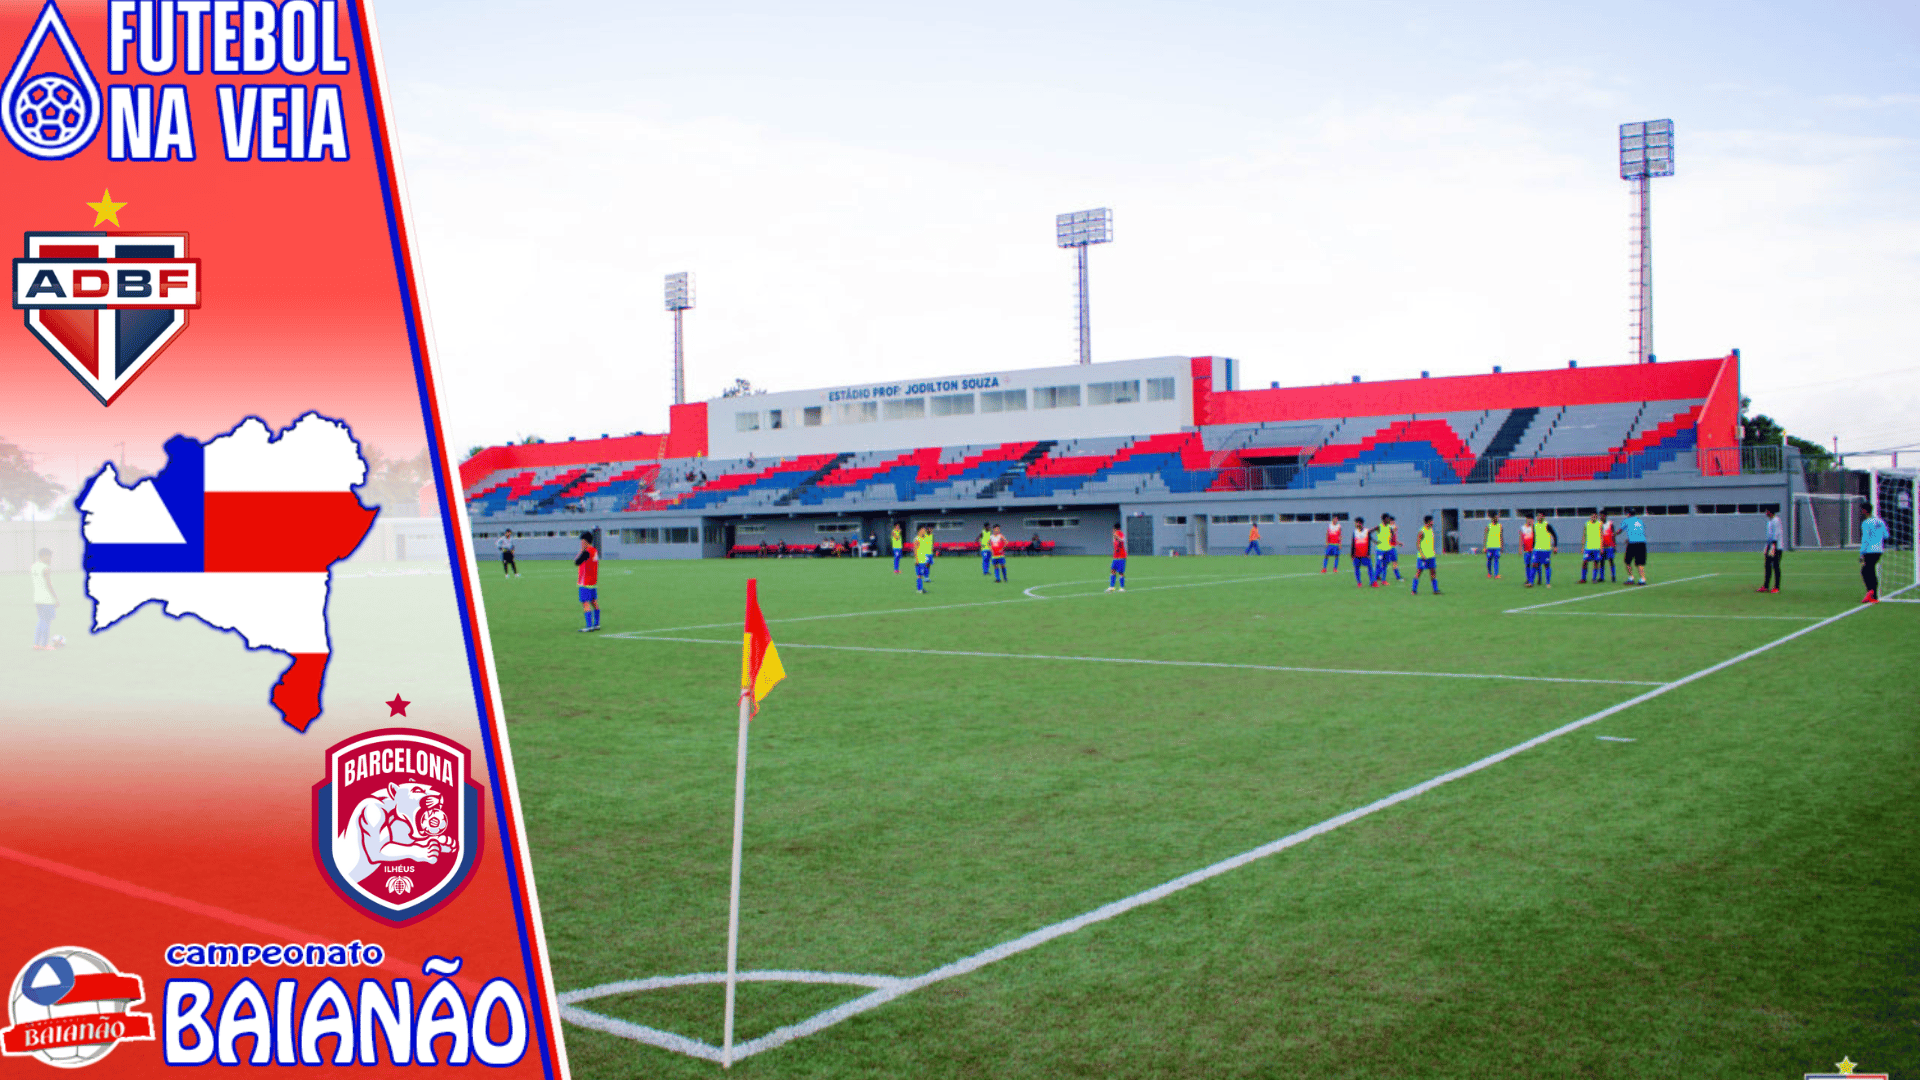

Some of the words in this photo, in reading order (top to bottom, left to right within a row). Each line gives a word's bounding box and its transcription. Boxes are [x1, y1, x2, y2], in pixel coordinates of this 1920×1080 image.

[828, 387, 871, 401] ESTÁDIO
[905, 380, 958, 396] JODILTON
[962, 377, 999, 390] SOUZA
